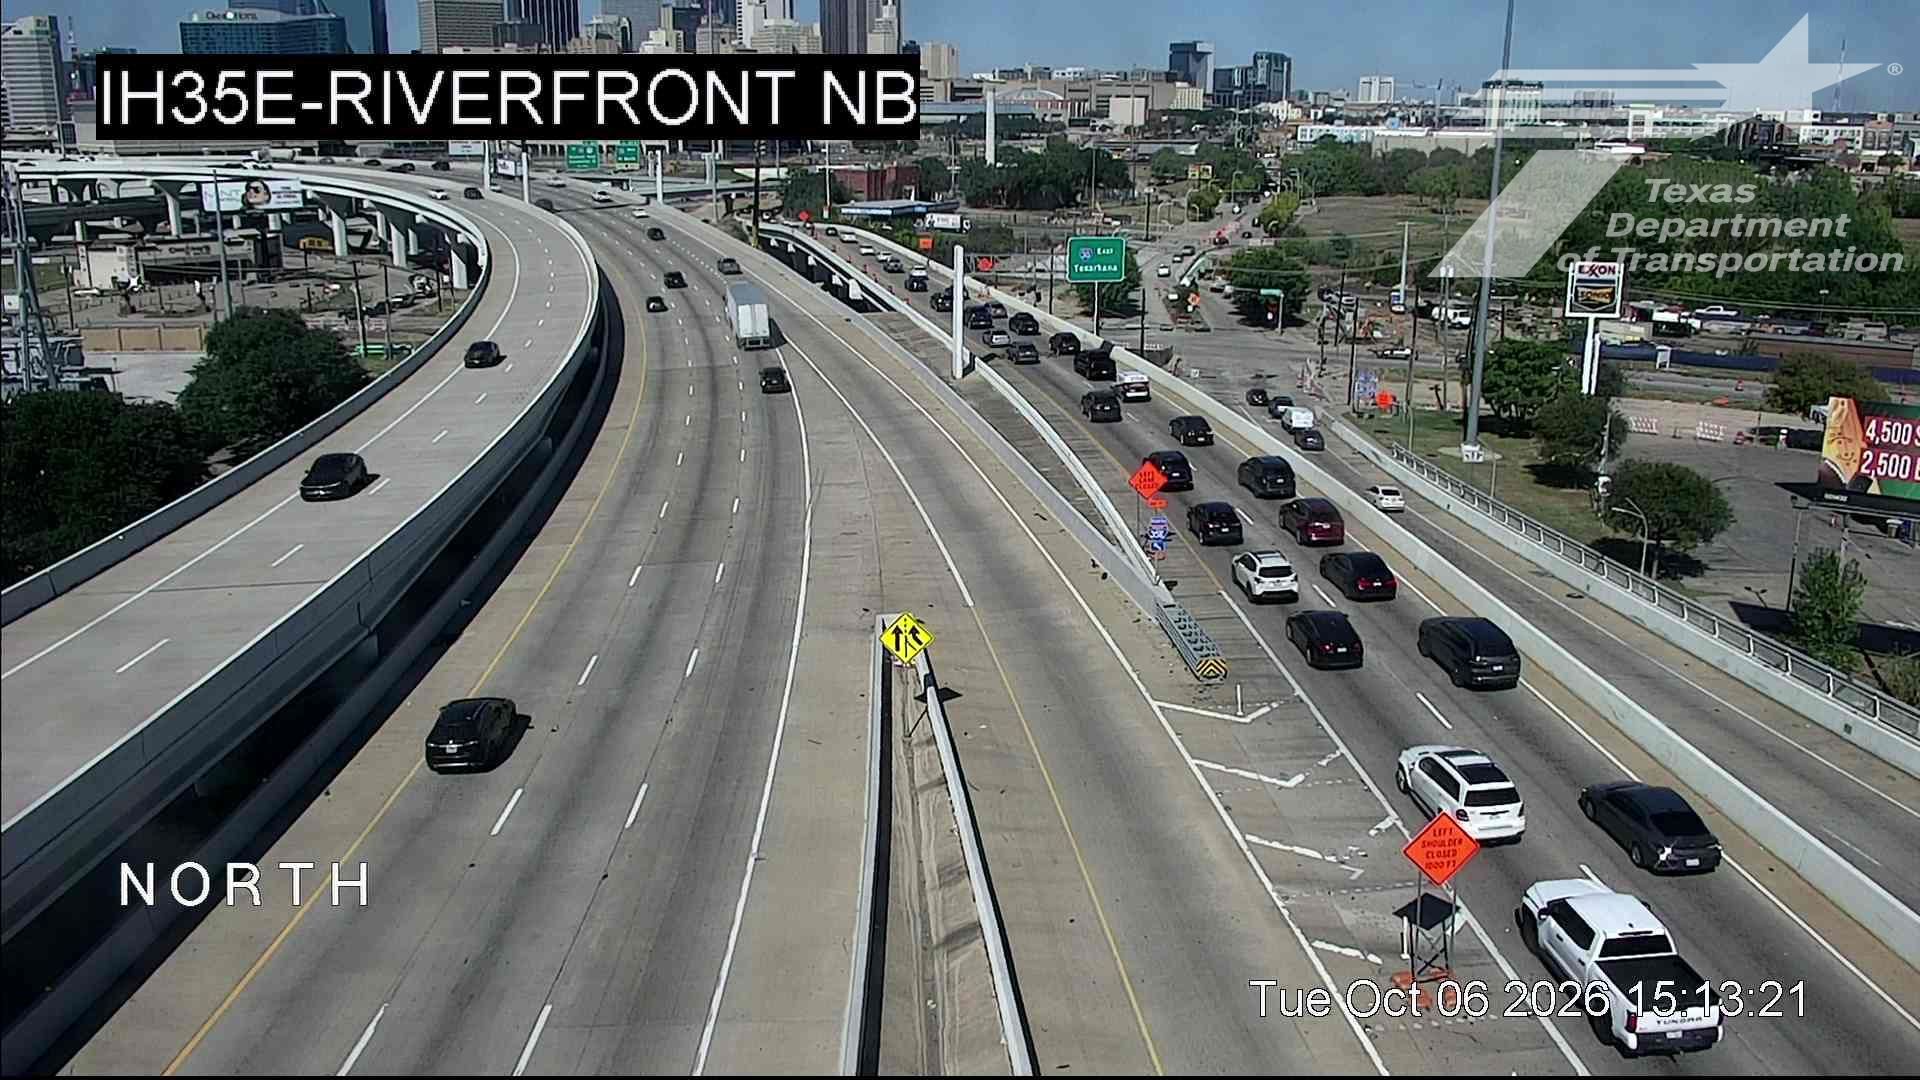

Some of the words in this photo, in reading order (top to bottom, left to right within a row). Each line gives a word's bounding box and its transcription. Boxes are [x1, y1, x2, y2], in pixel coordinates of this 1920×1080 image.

[1578, 264, 1616, 277] EXXON
[1865, 419, 1913, 445] 4,500
[1860, 450, 1912, 479] 2,500
[1432, 827, 1456, 837] LEFT
[1421, 838, 1463, 849] SHOULDER
[1425, 848, 1458, 859] CLOSED
[1425, 861, 1445, 870] 1000
[1446, 860, 1457, 868] FT
[1656, 1016, 1703, 1025] TUNDRA
